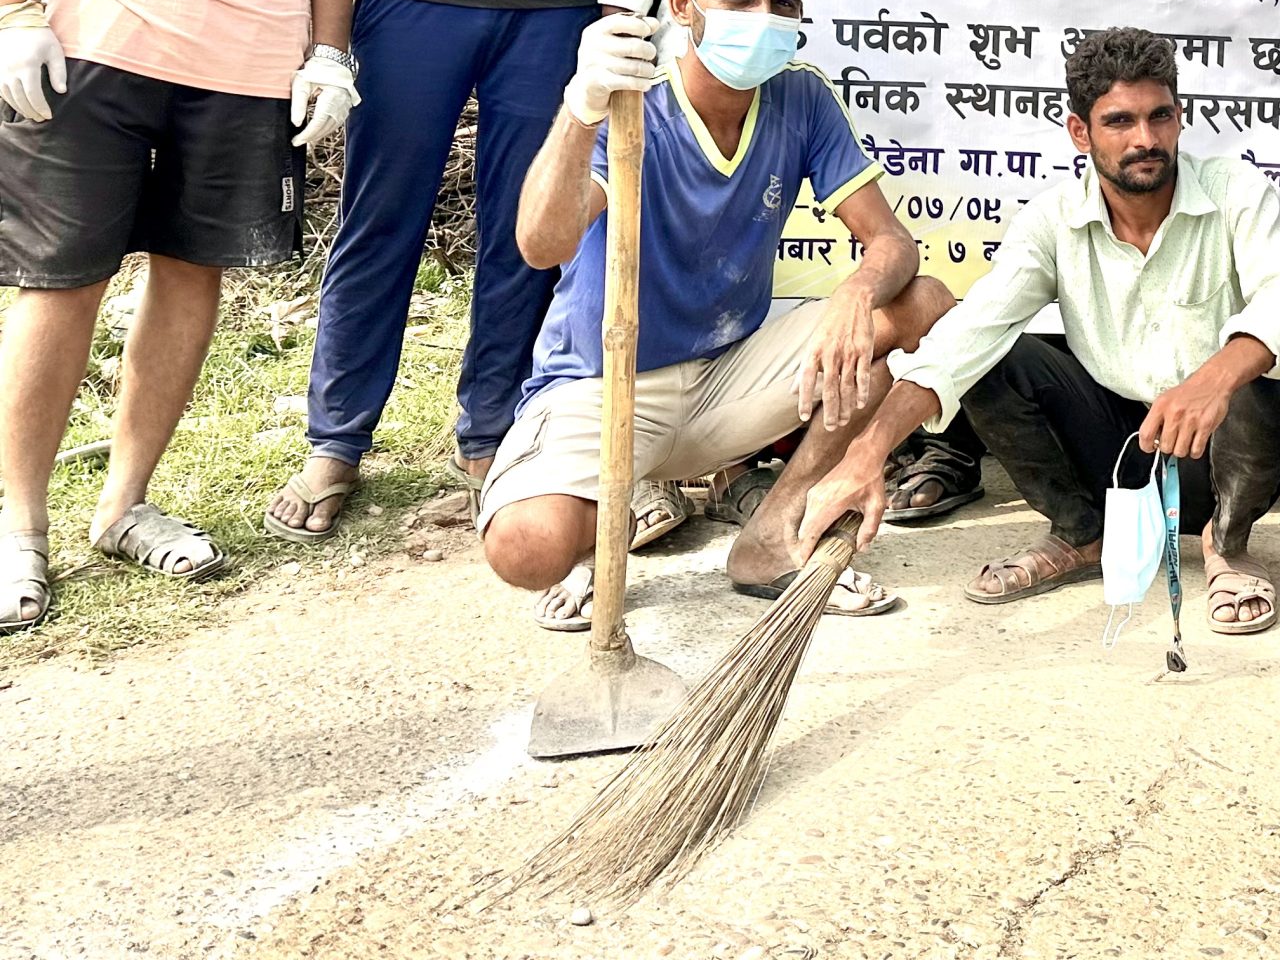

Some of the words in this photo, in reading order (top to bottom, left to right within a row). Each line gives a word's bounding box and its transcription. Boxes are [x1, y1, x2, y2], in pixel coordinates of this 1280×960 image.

[832, 8, 949, 56] पर्वको
[966, 23, 1040, 70] शुभ
[283, 178, 293, 211] SPORTS
[947, 241, 966, 264] ७
